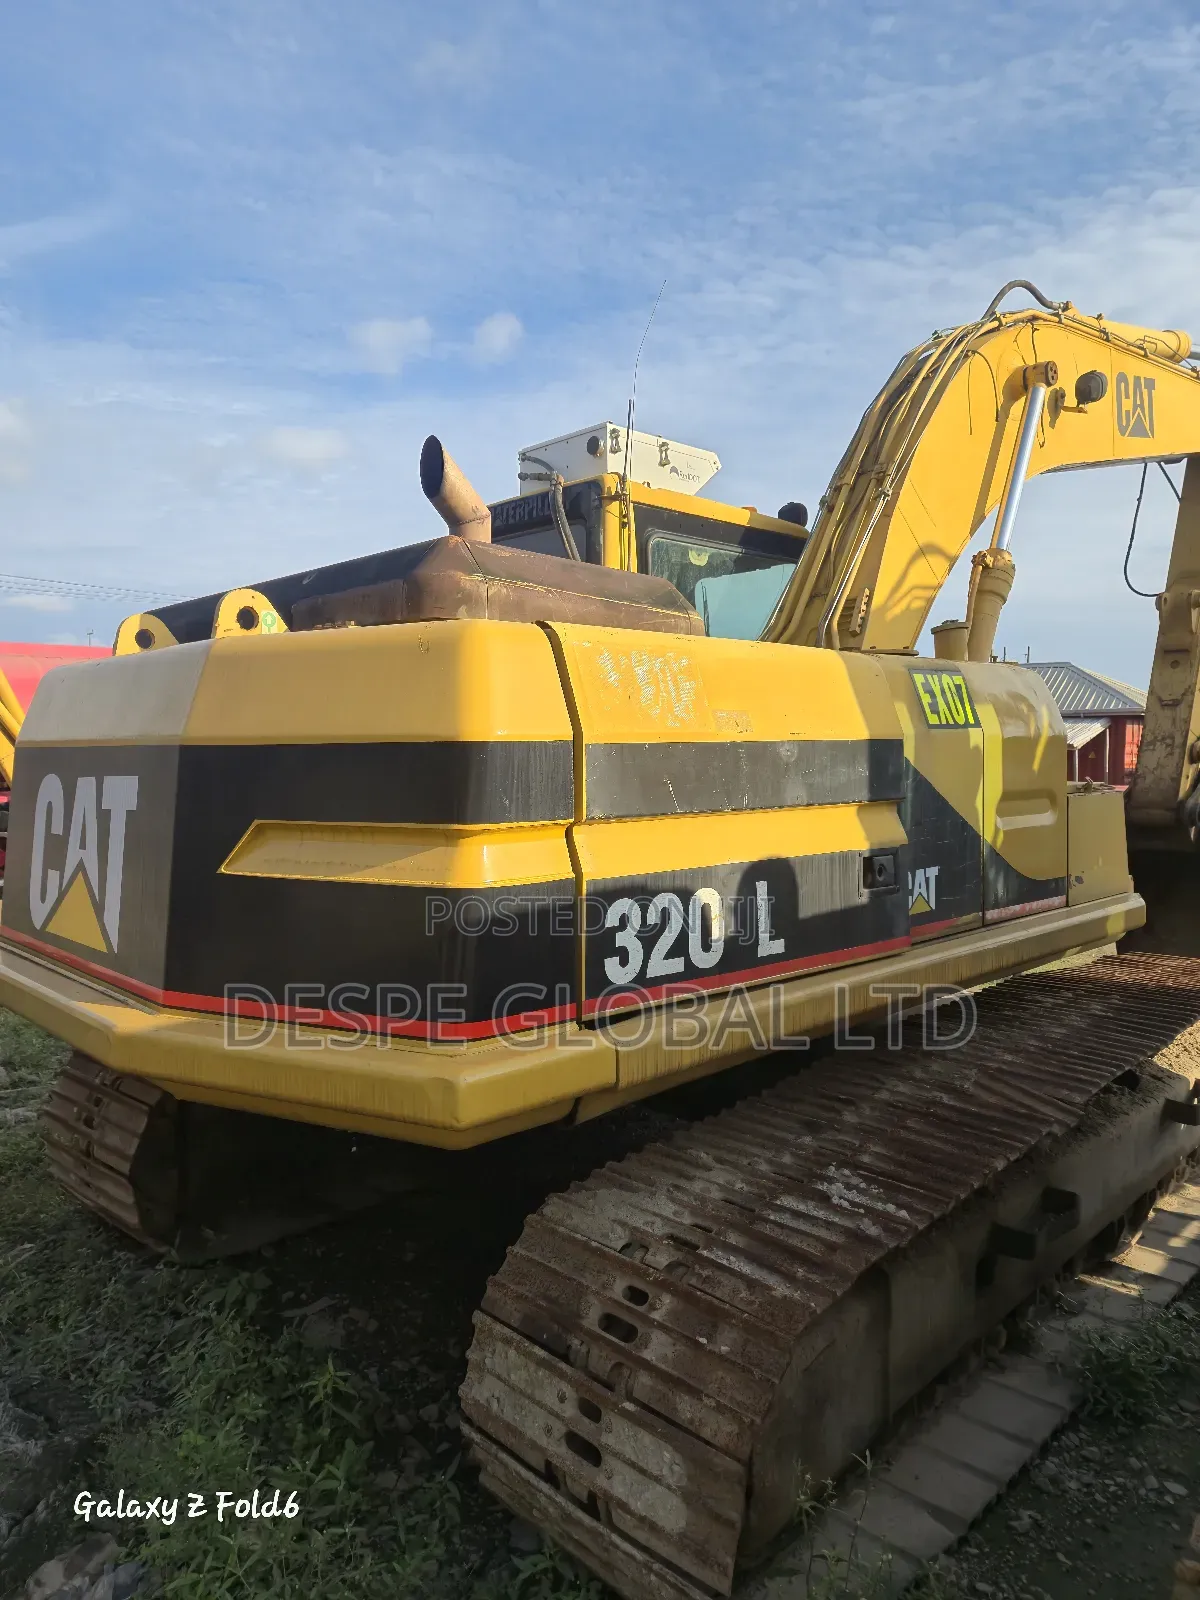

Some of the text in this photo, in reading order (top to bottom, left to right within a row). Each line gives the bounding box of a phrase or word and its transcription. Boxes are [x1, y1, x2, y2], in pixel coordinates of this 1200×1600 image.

[1115, 371, 1156, 439] CAT
[912, 673, 975, 725] EX07
[29, 773, 139, 954] CAT
[603, 880, 785, 985] 320 L
